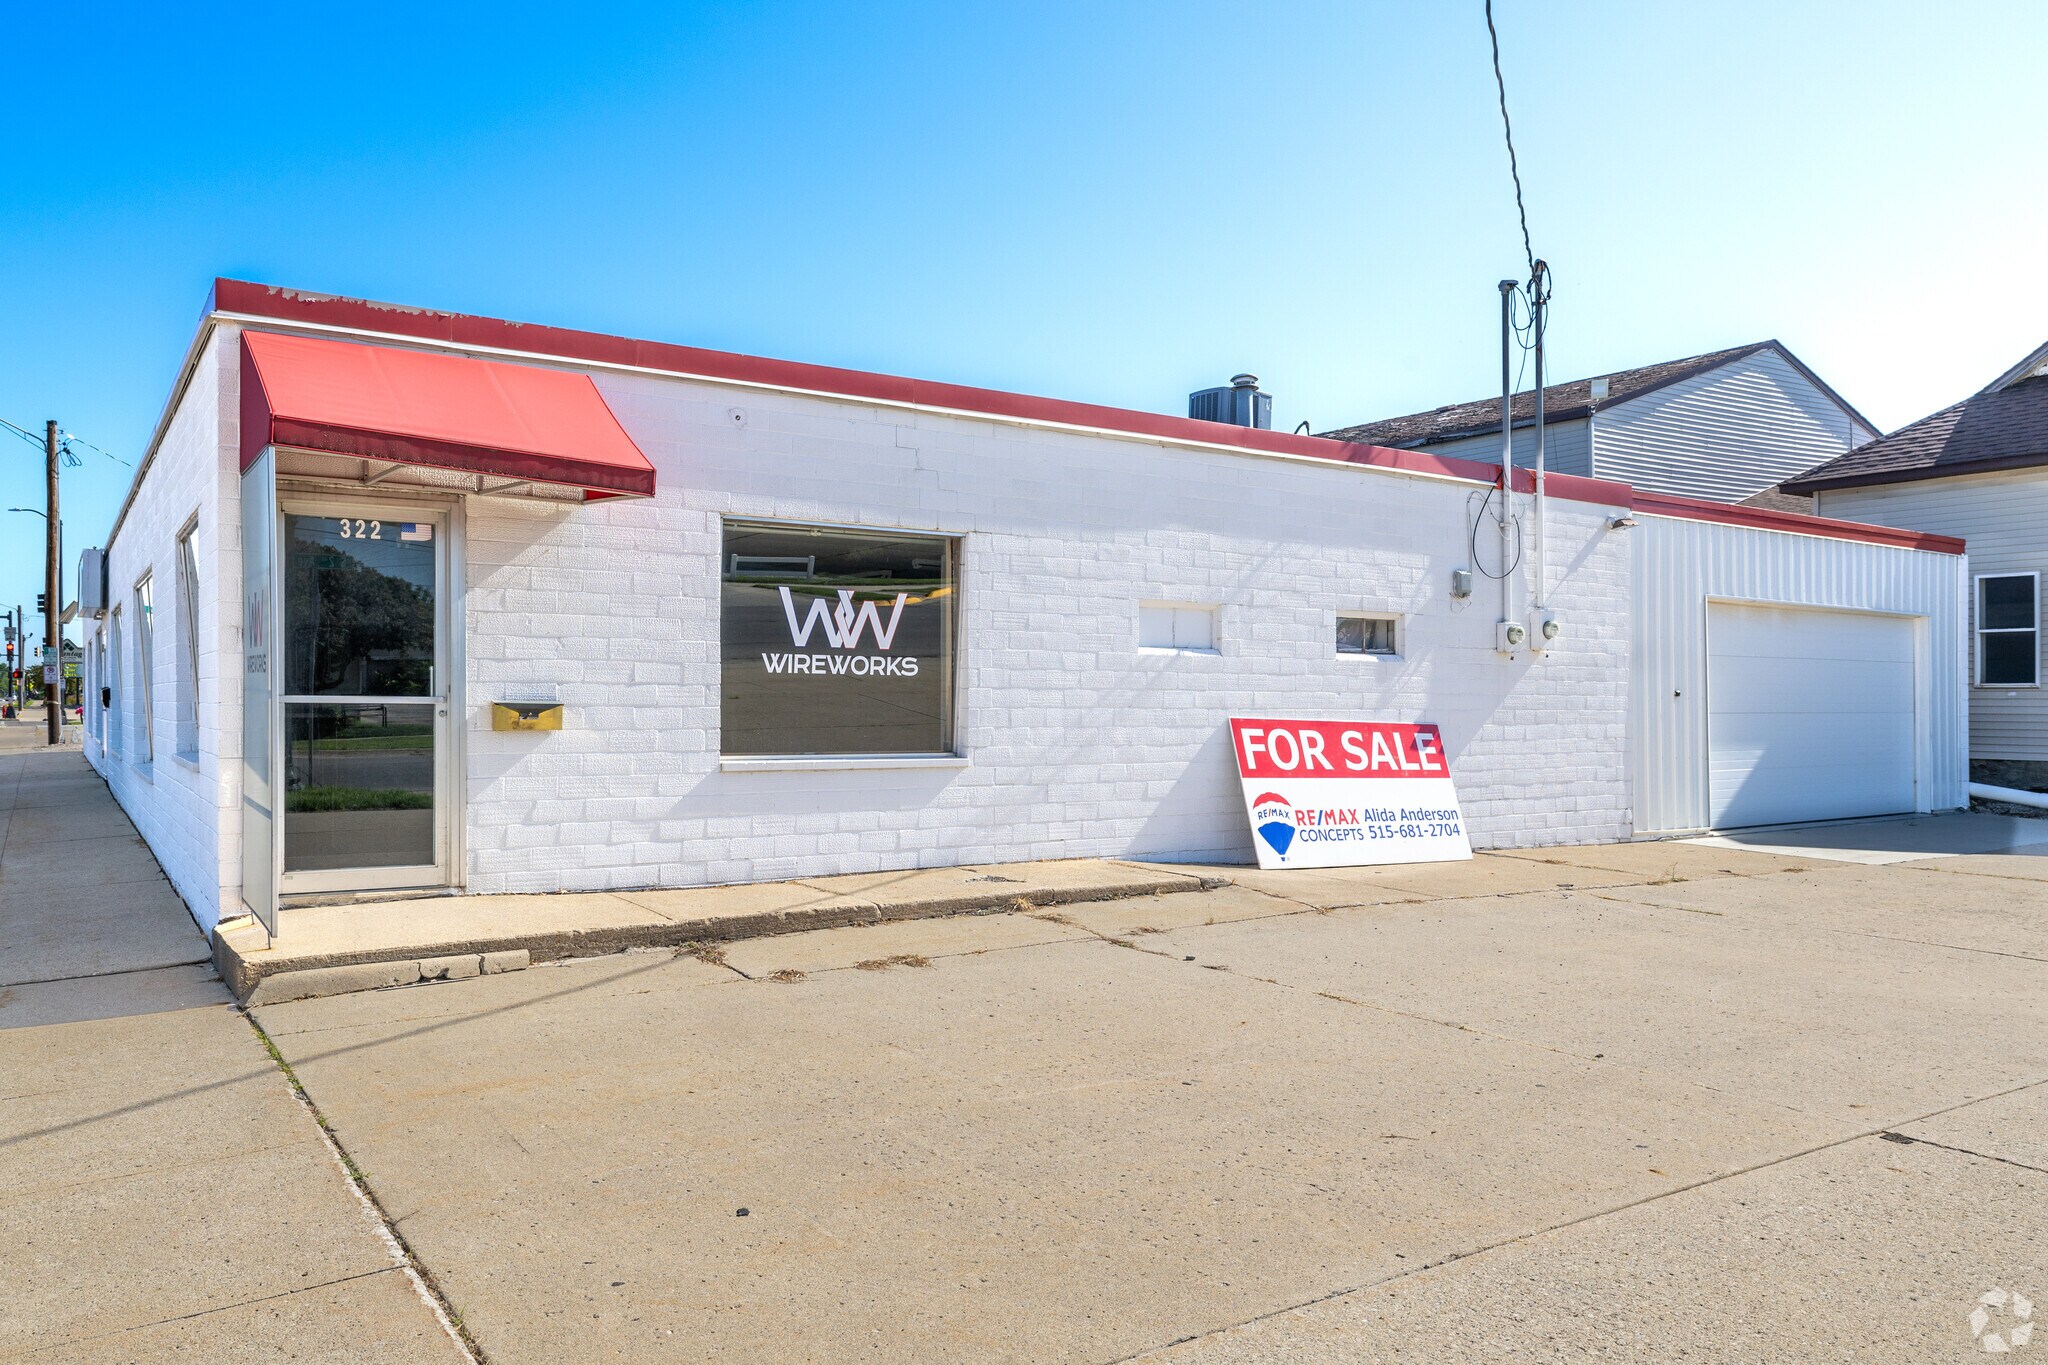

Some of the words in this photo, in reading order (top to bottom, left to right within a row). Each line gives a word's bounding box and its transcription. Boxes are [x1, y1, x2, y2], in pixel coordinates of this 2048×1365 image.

[340, 518, 381, 540] 322
[762, 652, 919, 677] WIREWORKS
[1240, 728, 1334, 771] FOR
[1341, 730, 1442, 771] SALE
[1257, 808, 1291, 820] RE/MAX
[1295, 808, 1360, 826] RE/MAX
[1364, 807, 1396, 823] Alida
[1400, 807, 1459, 822] Anderson
[1300, 827, 1364, 842] CONCEPTS
[1369, 823, 1460, 839] 515-681-2704
